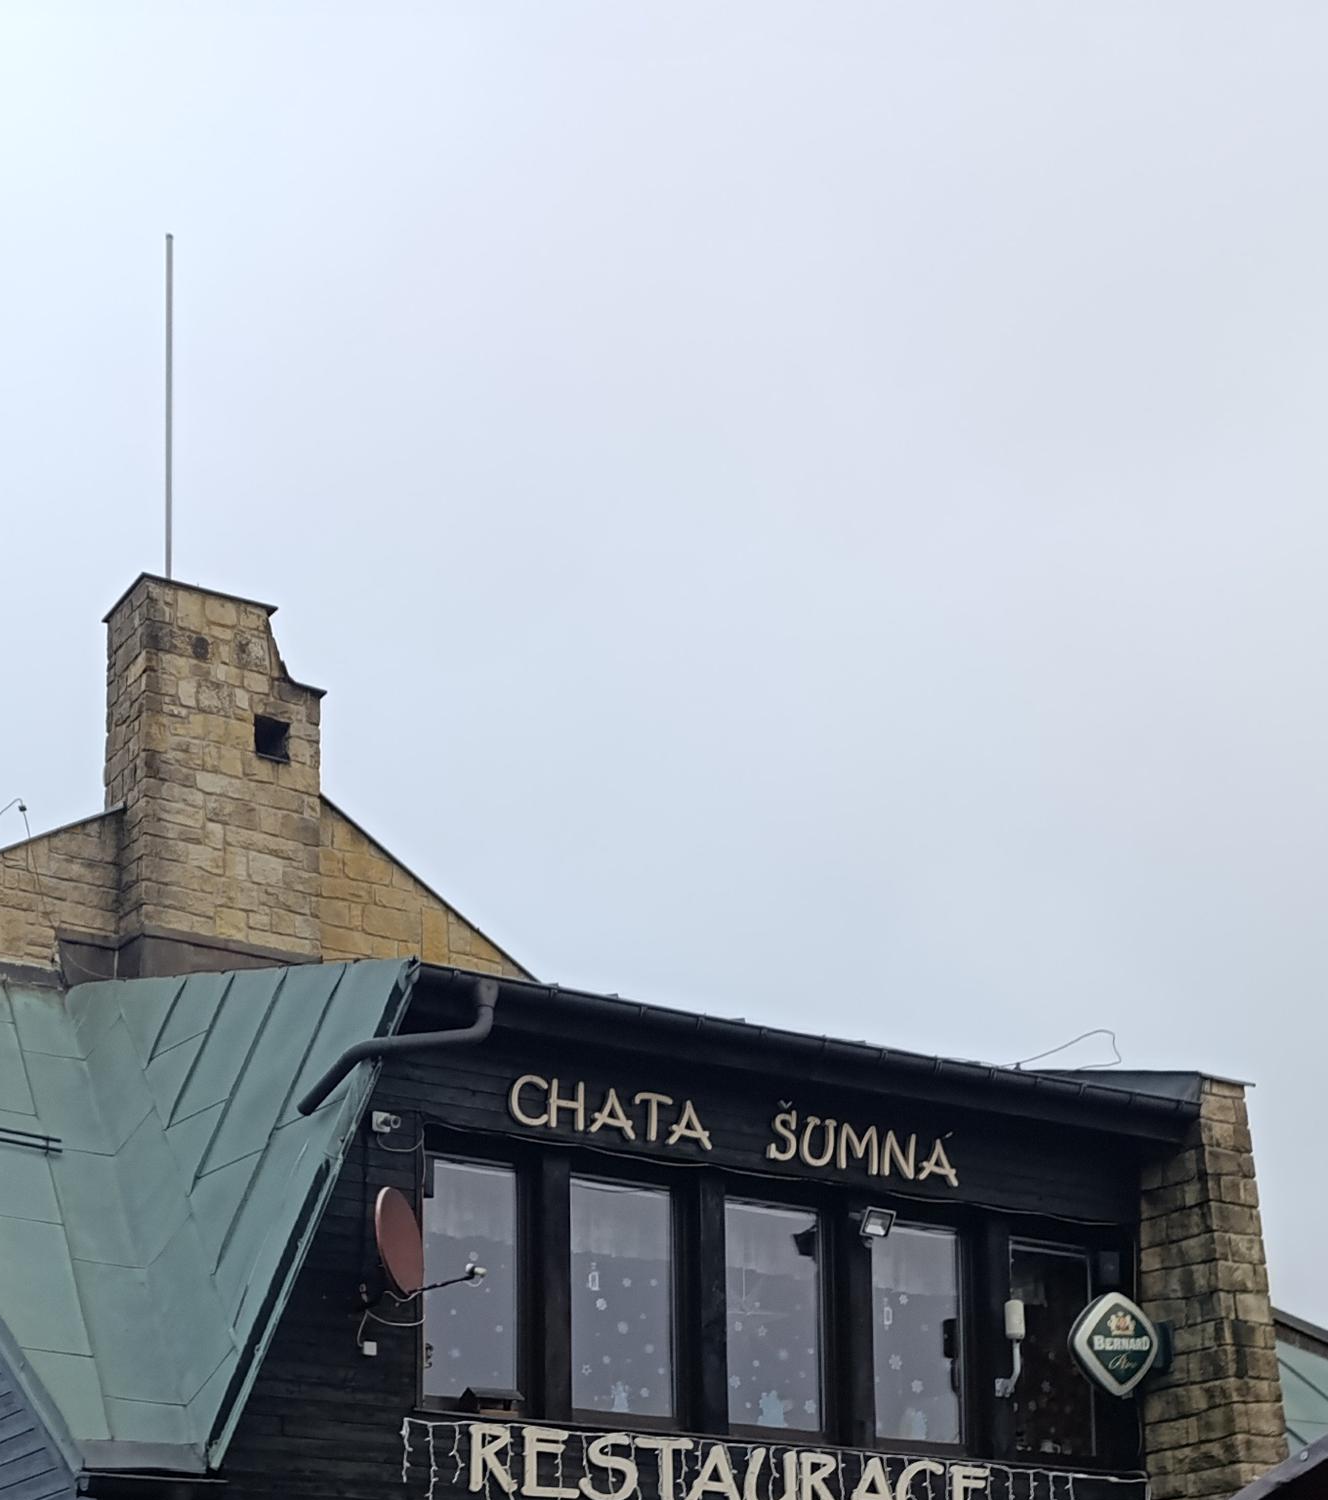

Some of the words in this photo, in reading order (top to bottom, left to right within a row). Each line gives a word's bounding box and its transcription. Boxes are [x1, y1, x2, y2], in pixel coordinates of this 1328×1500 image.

[507, 1074, 713, 1151] CHATA
[766, 1099, 958, 1188] ŠUMNÁ
[1093, 1335, 1150, 1351] BERNARD
